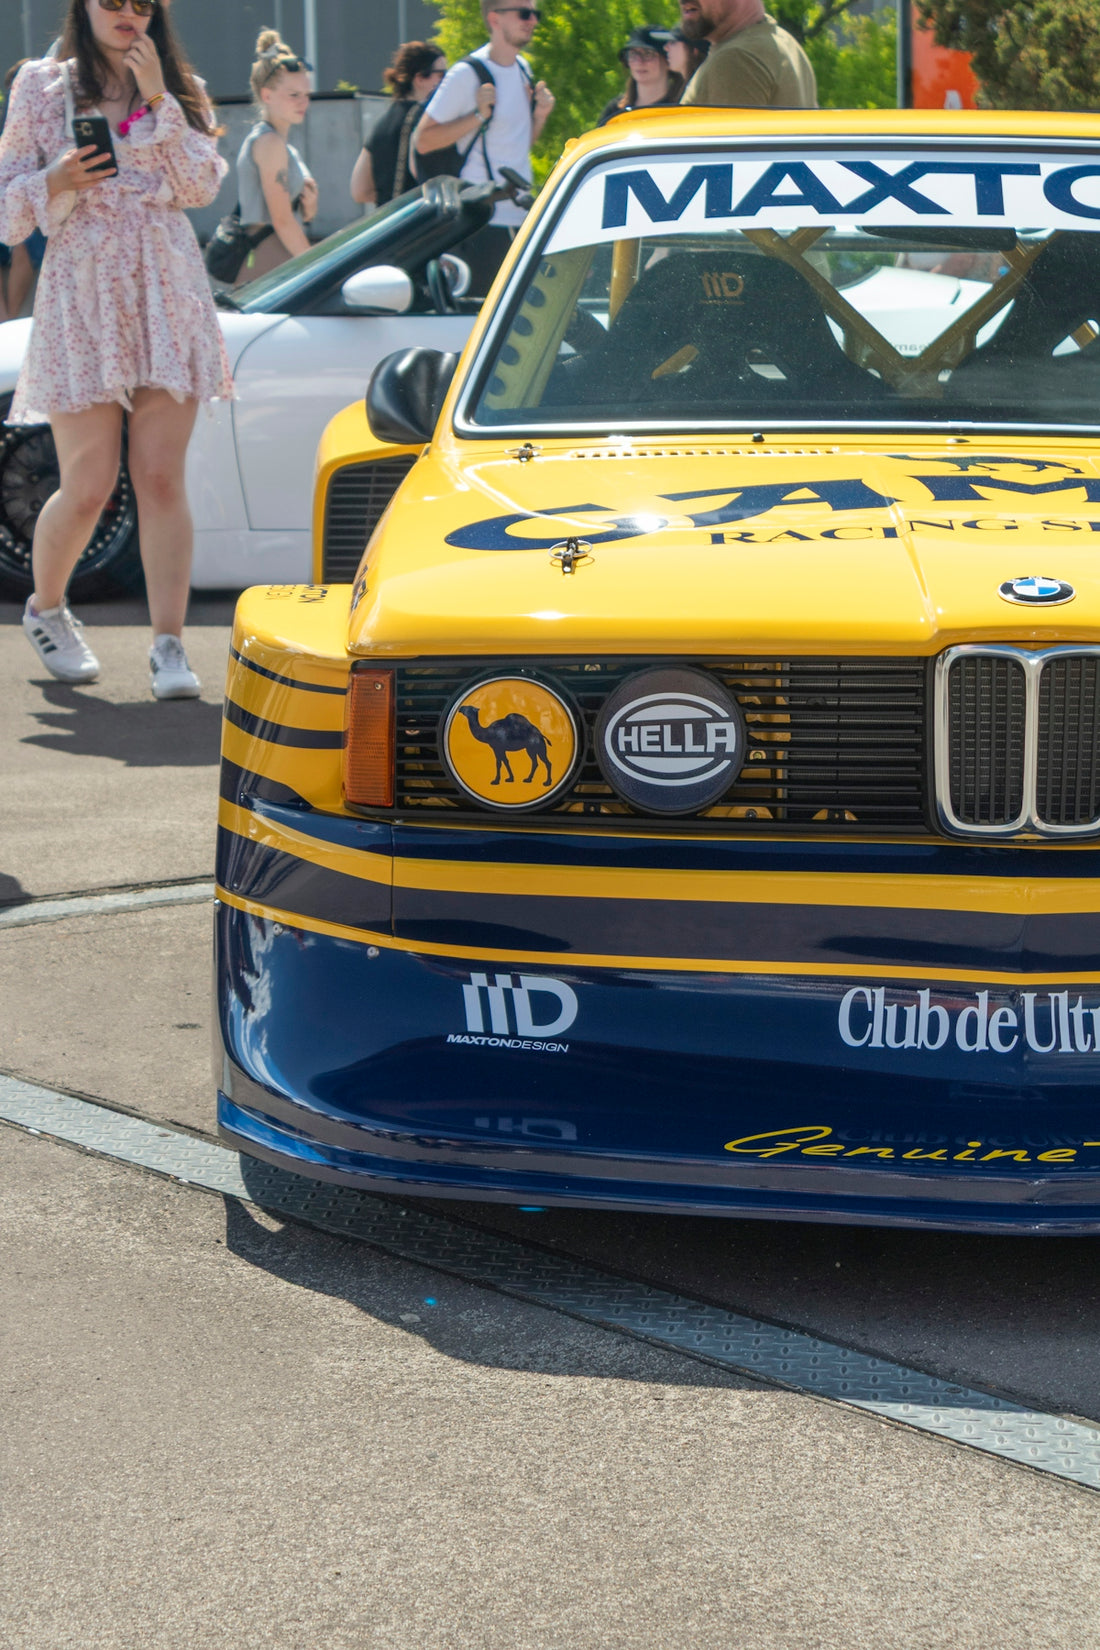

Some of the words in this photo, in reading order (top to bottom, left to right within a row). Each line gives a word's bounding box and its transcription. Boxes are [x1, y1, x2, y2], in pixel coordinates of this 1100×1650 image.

[704, 519, 1019, 545] RACING
[618, 721, 736, 752] HELLA
[838, 986, 950, 1050] Club
[955, 989, 1019, 1053] de
[723, 1126, 1078, 1162] Genuine
